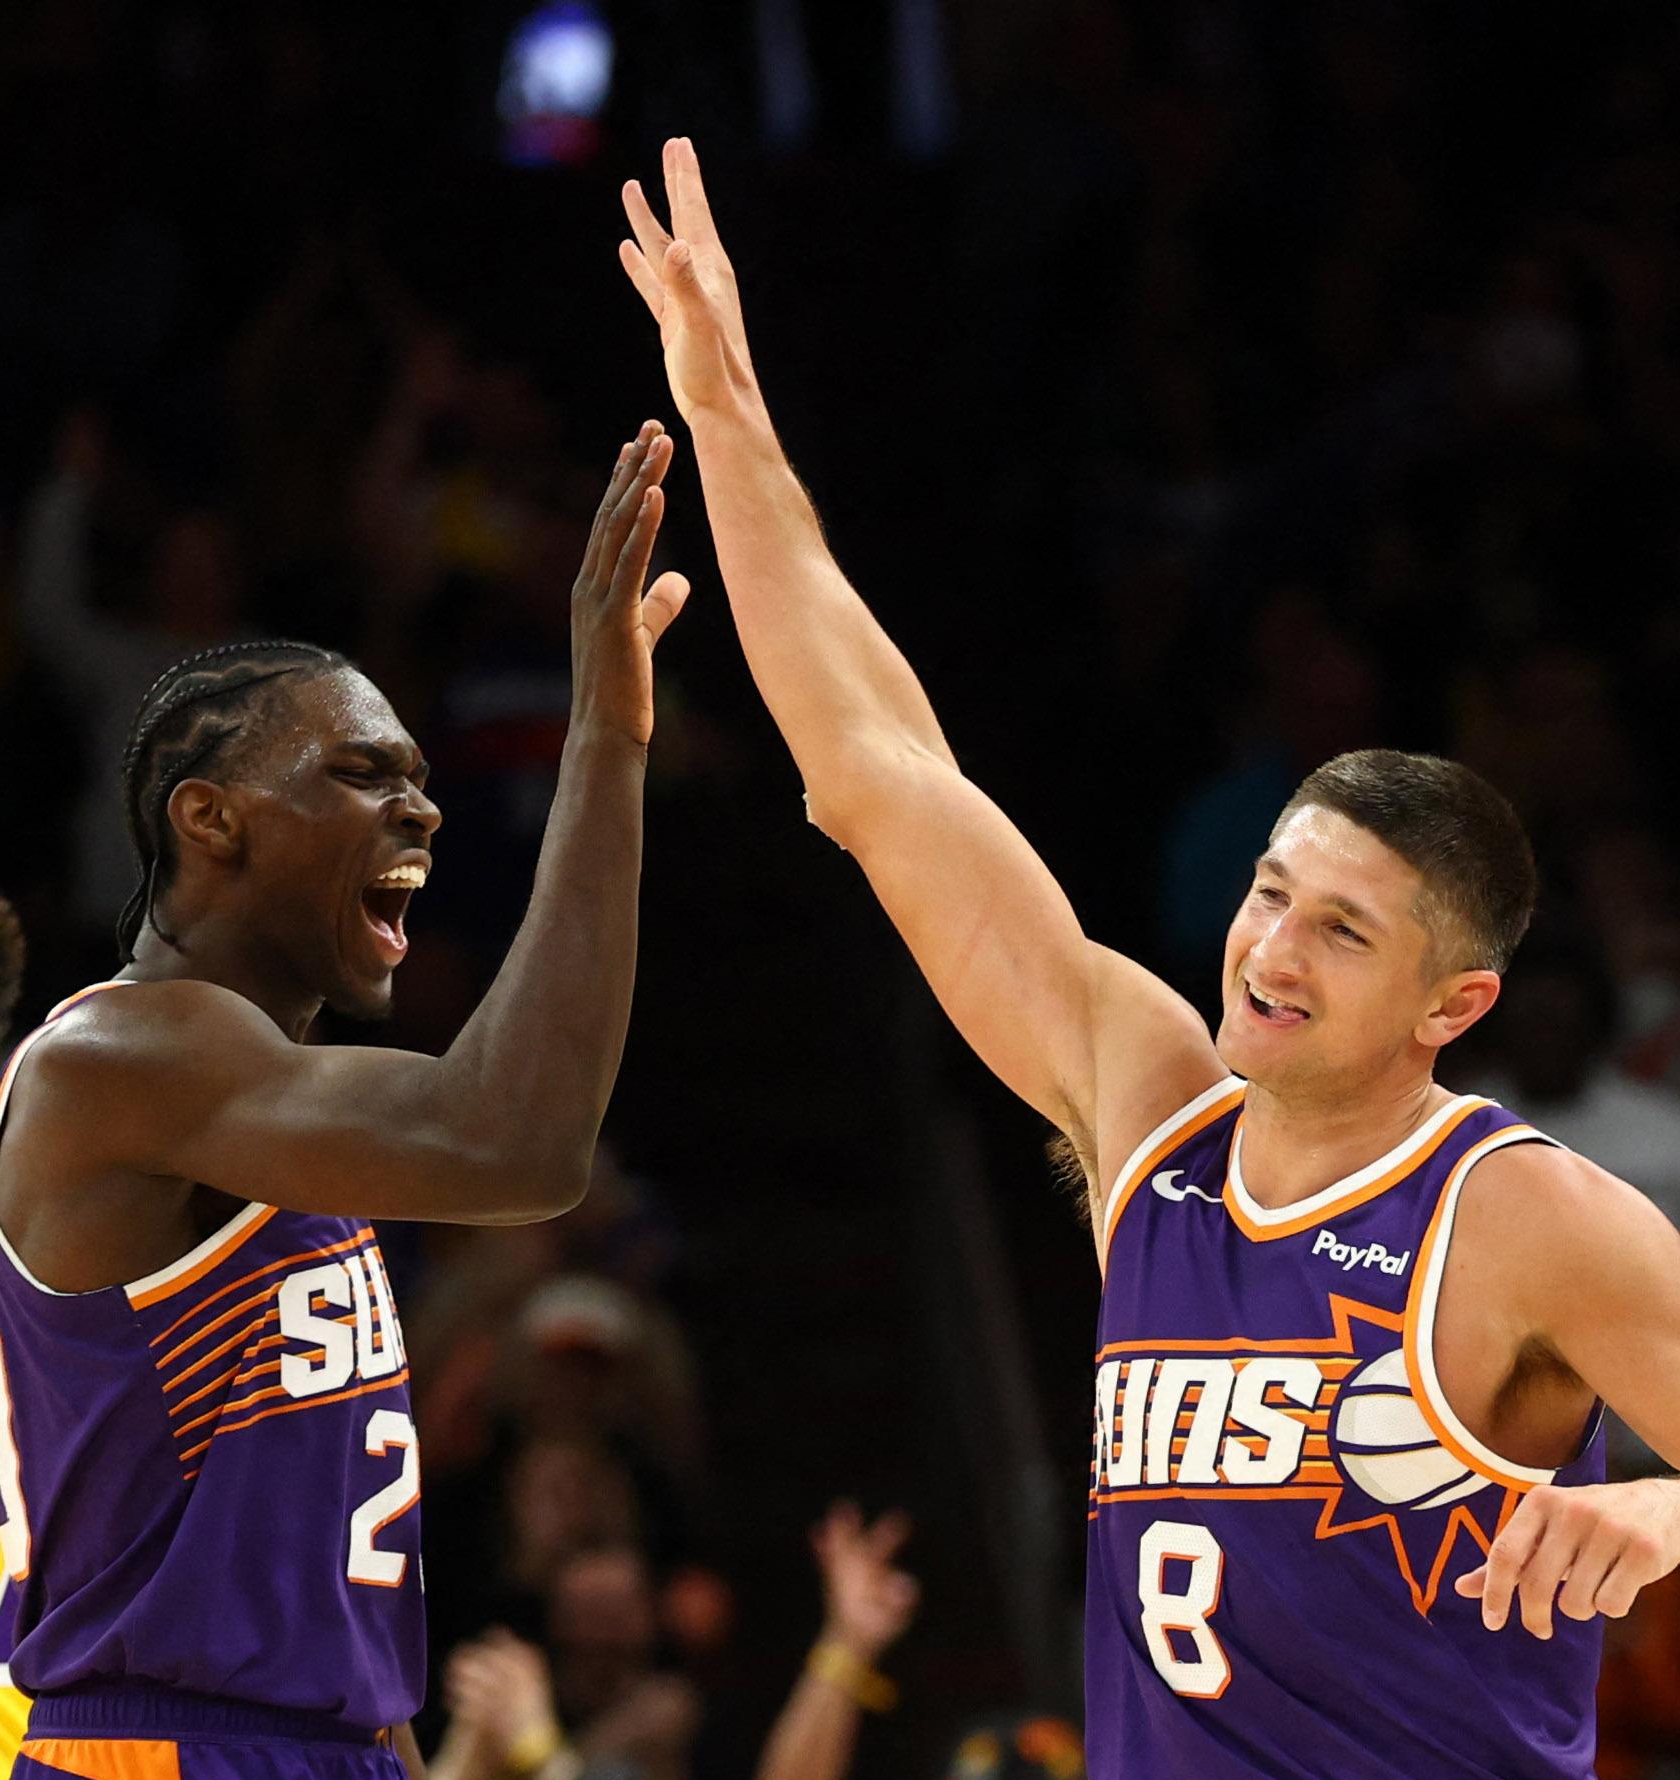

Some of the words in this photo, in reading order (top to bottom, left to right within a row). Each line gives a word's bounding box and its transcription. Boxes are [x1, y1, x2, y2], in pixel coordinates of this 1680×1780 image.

[277, 1246, 406, 1399] SU
[1311, 1229, 1411, 1276] PayPal
[1095, 1357, 1323, 1488] UNS
[1138, 1520, 1231, 1699] 8
